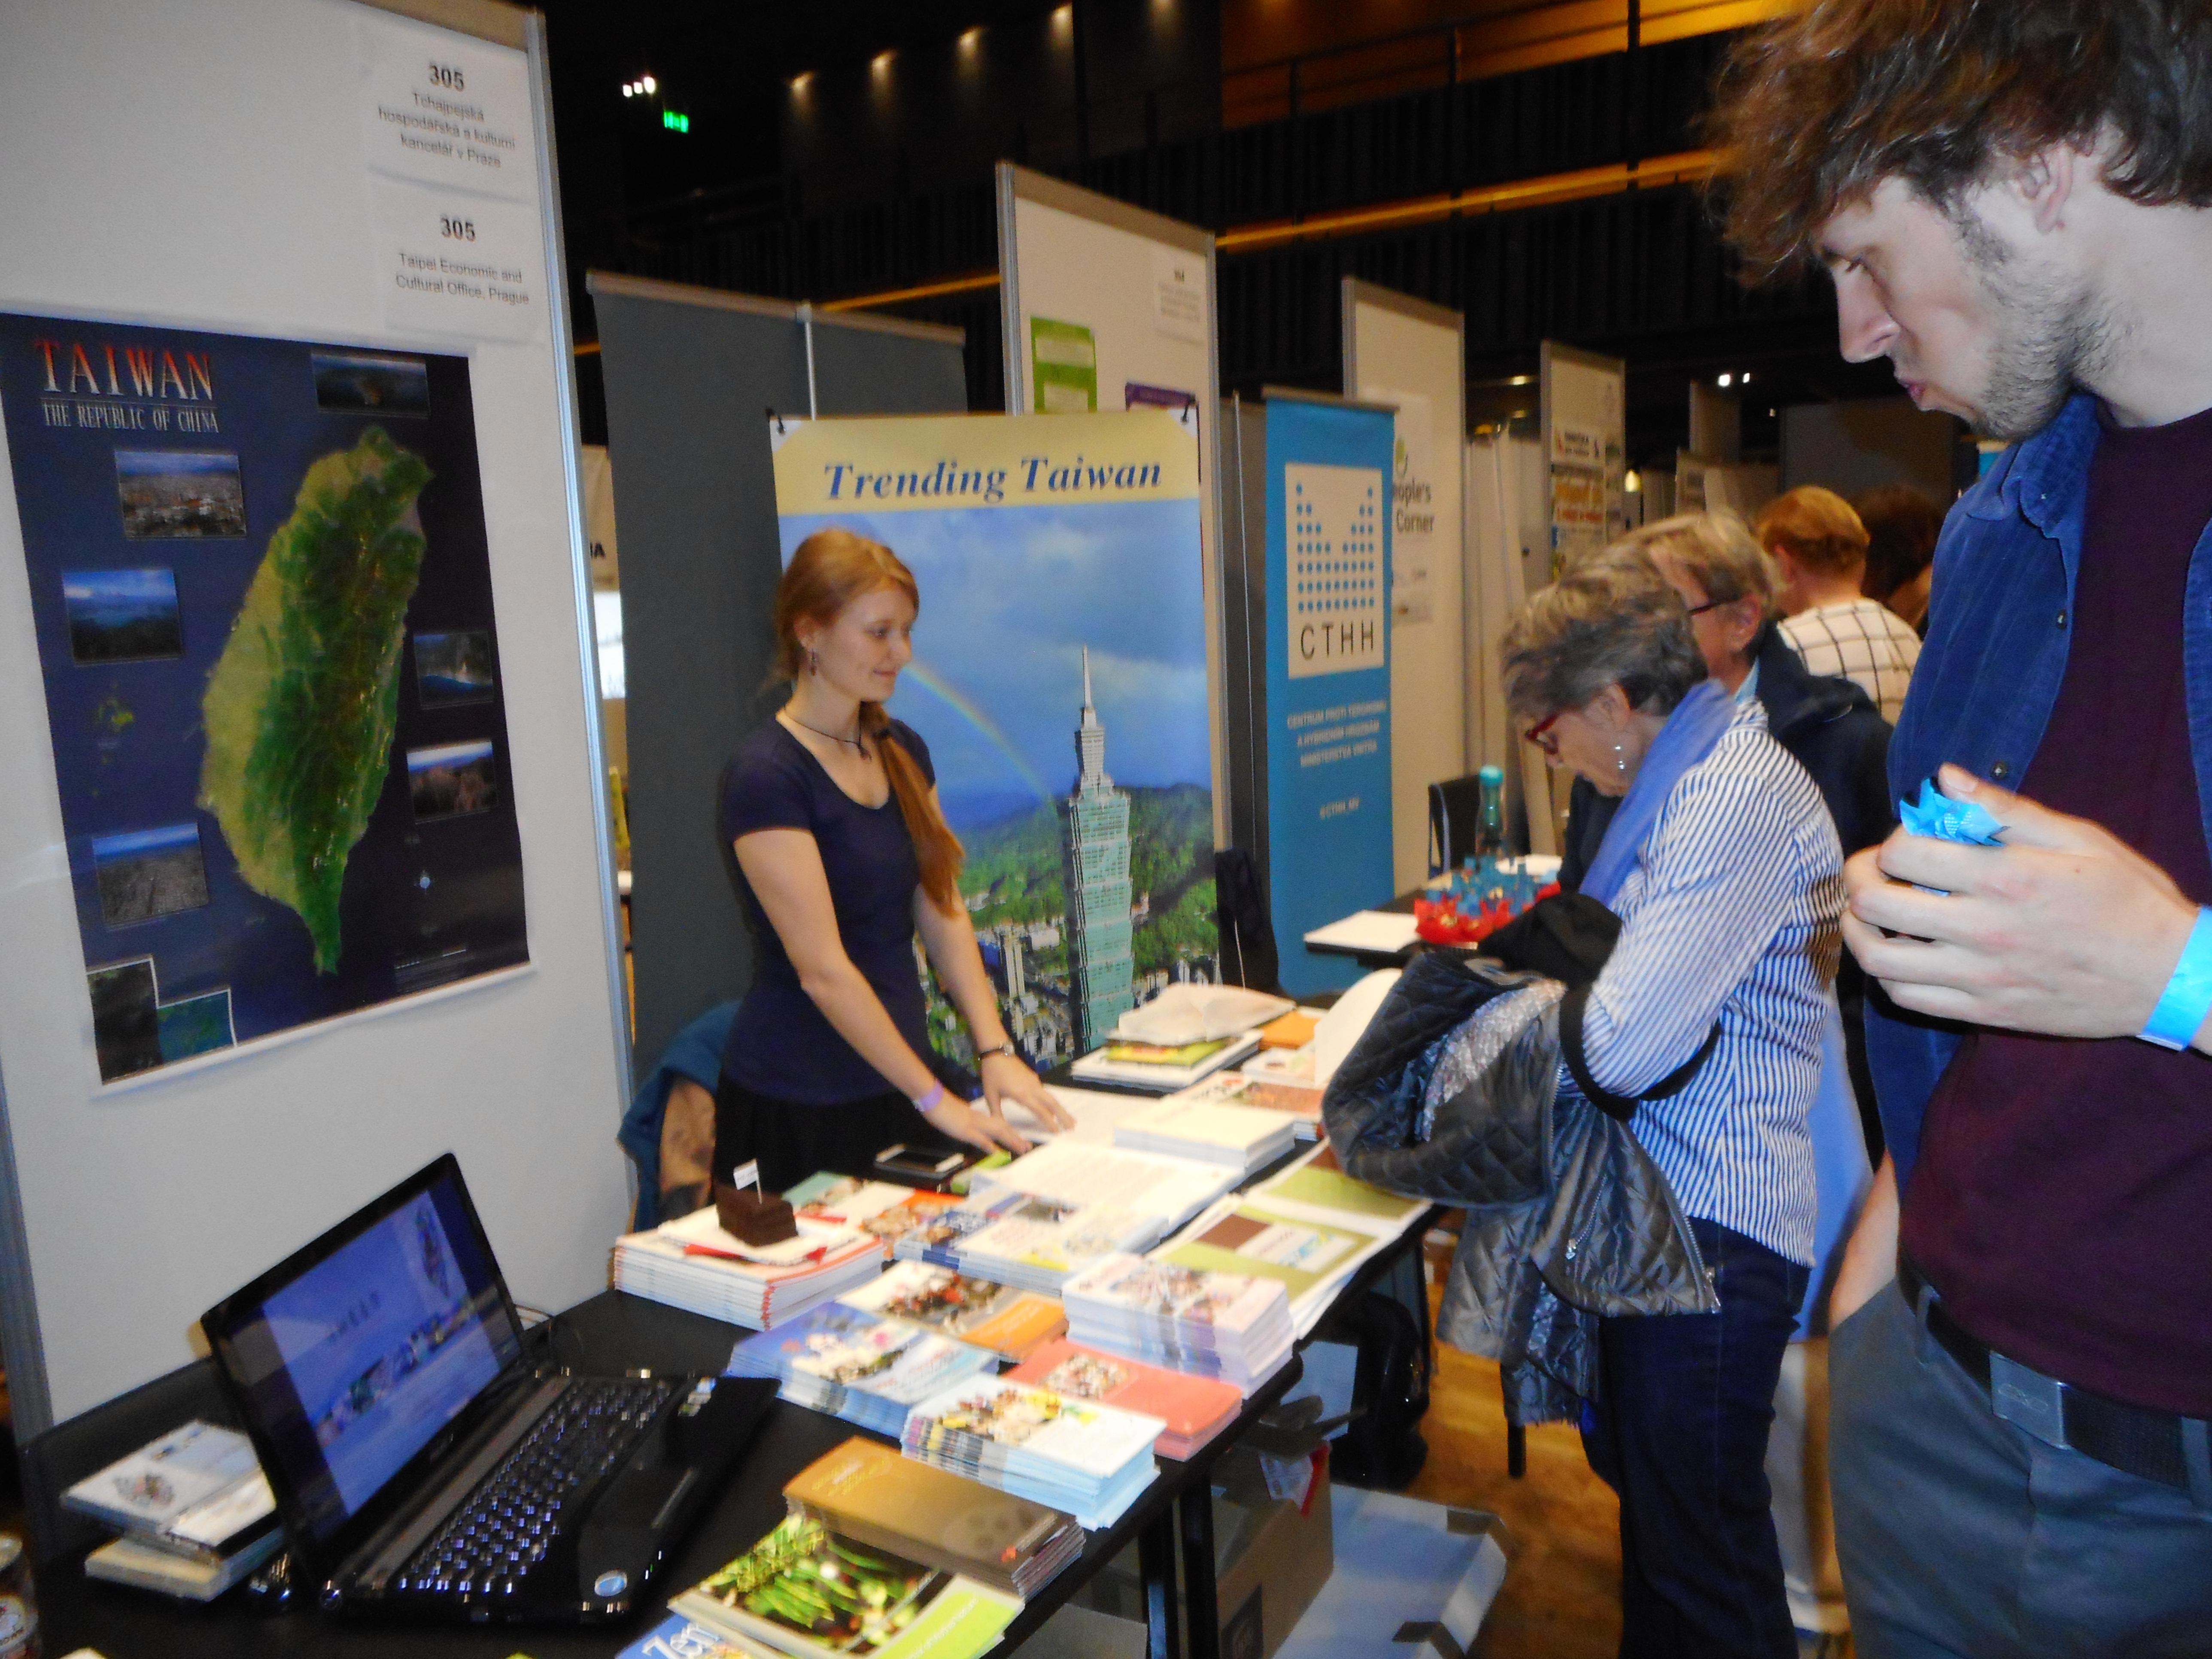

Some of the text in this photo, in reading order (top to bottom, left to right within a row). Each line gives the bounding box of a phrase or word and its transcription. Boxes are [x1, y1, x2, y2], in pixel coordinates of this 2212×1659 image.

[429, 64, 465, 92] 305
[468, 148, 501, 168] Praze
[440, 216, 476, 242] 305
[399, 252, 522, 284] Taipei Economic and
[396, 274, 529, 306] Cultural Office, Prague
[36, 339, 213, 401] TAIWAN
[43, 401, 219, 433] THE REPUBLIC OF CHINA
[824, 455, 1161, 504] Trending Taiwan
[1396, 508, 1435, 533] Corner
[1300, 620, 1374, 659] CTHH
